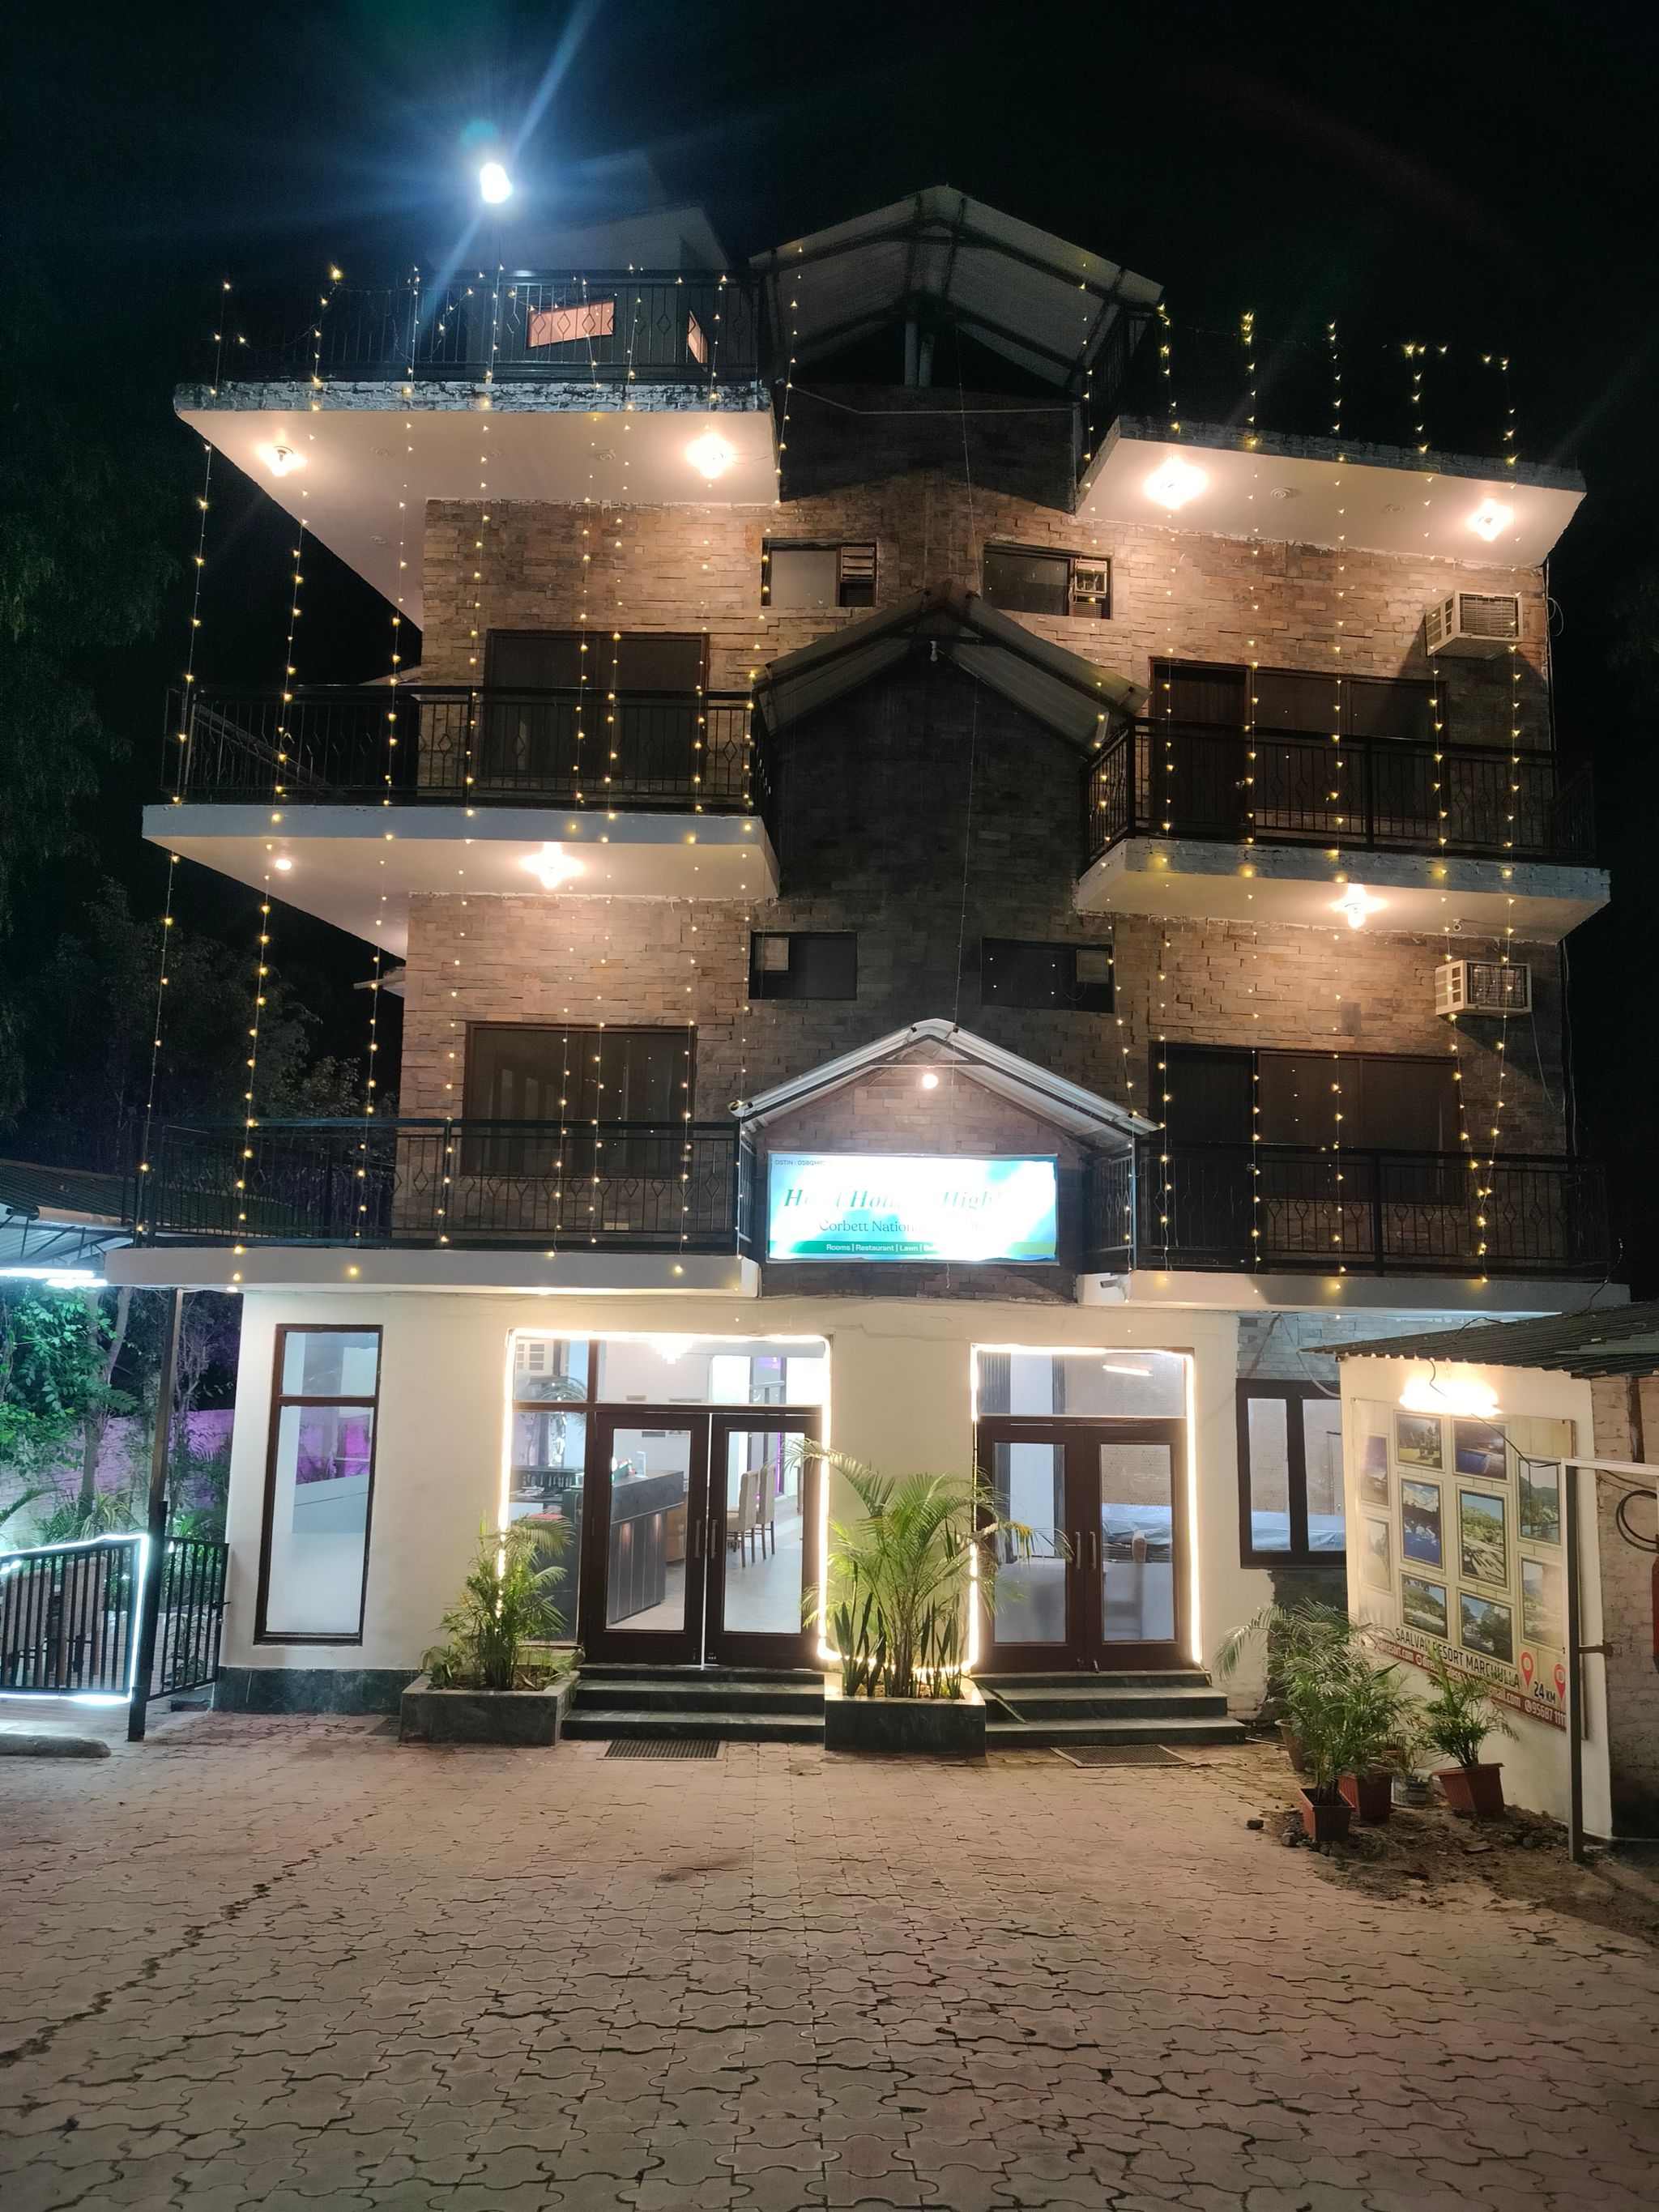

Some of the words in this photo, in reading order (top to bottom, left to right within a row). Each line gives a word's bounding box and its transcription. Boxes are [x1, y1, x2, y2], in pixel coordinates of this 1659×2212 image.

[819, 1220, 869, 1232] Corbett
[1533, 1681, 1545, 1700] 24
[1546, 1690, 1556, 1705] KM
